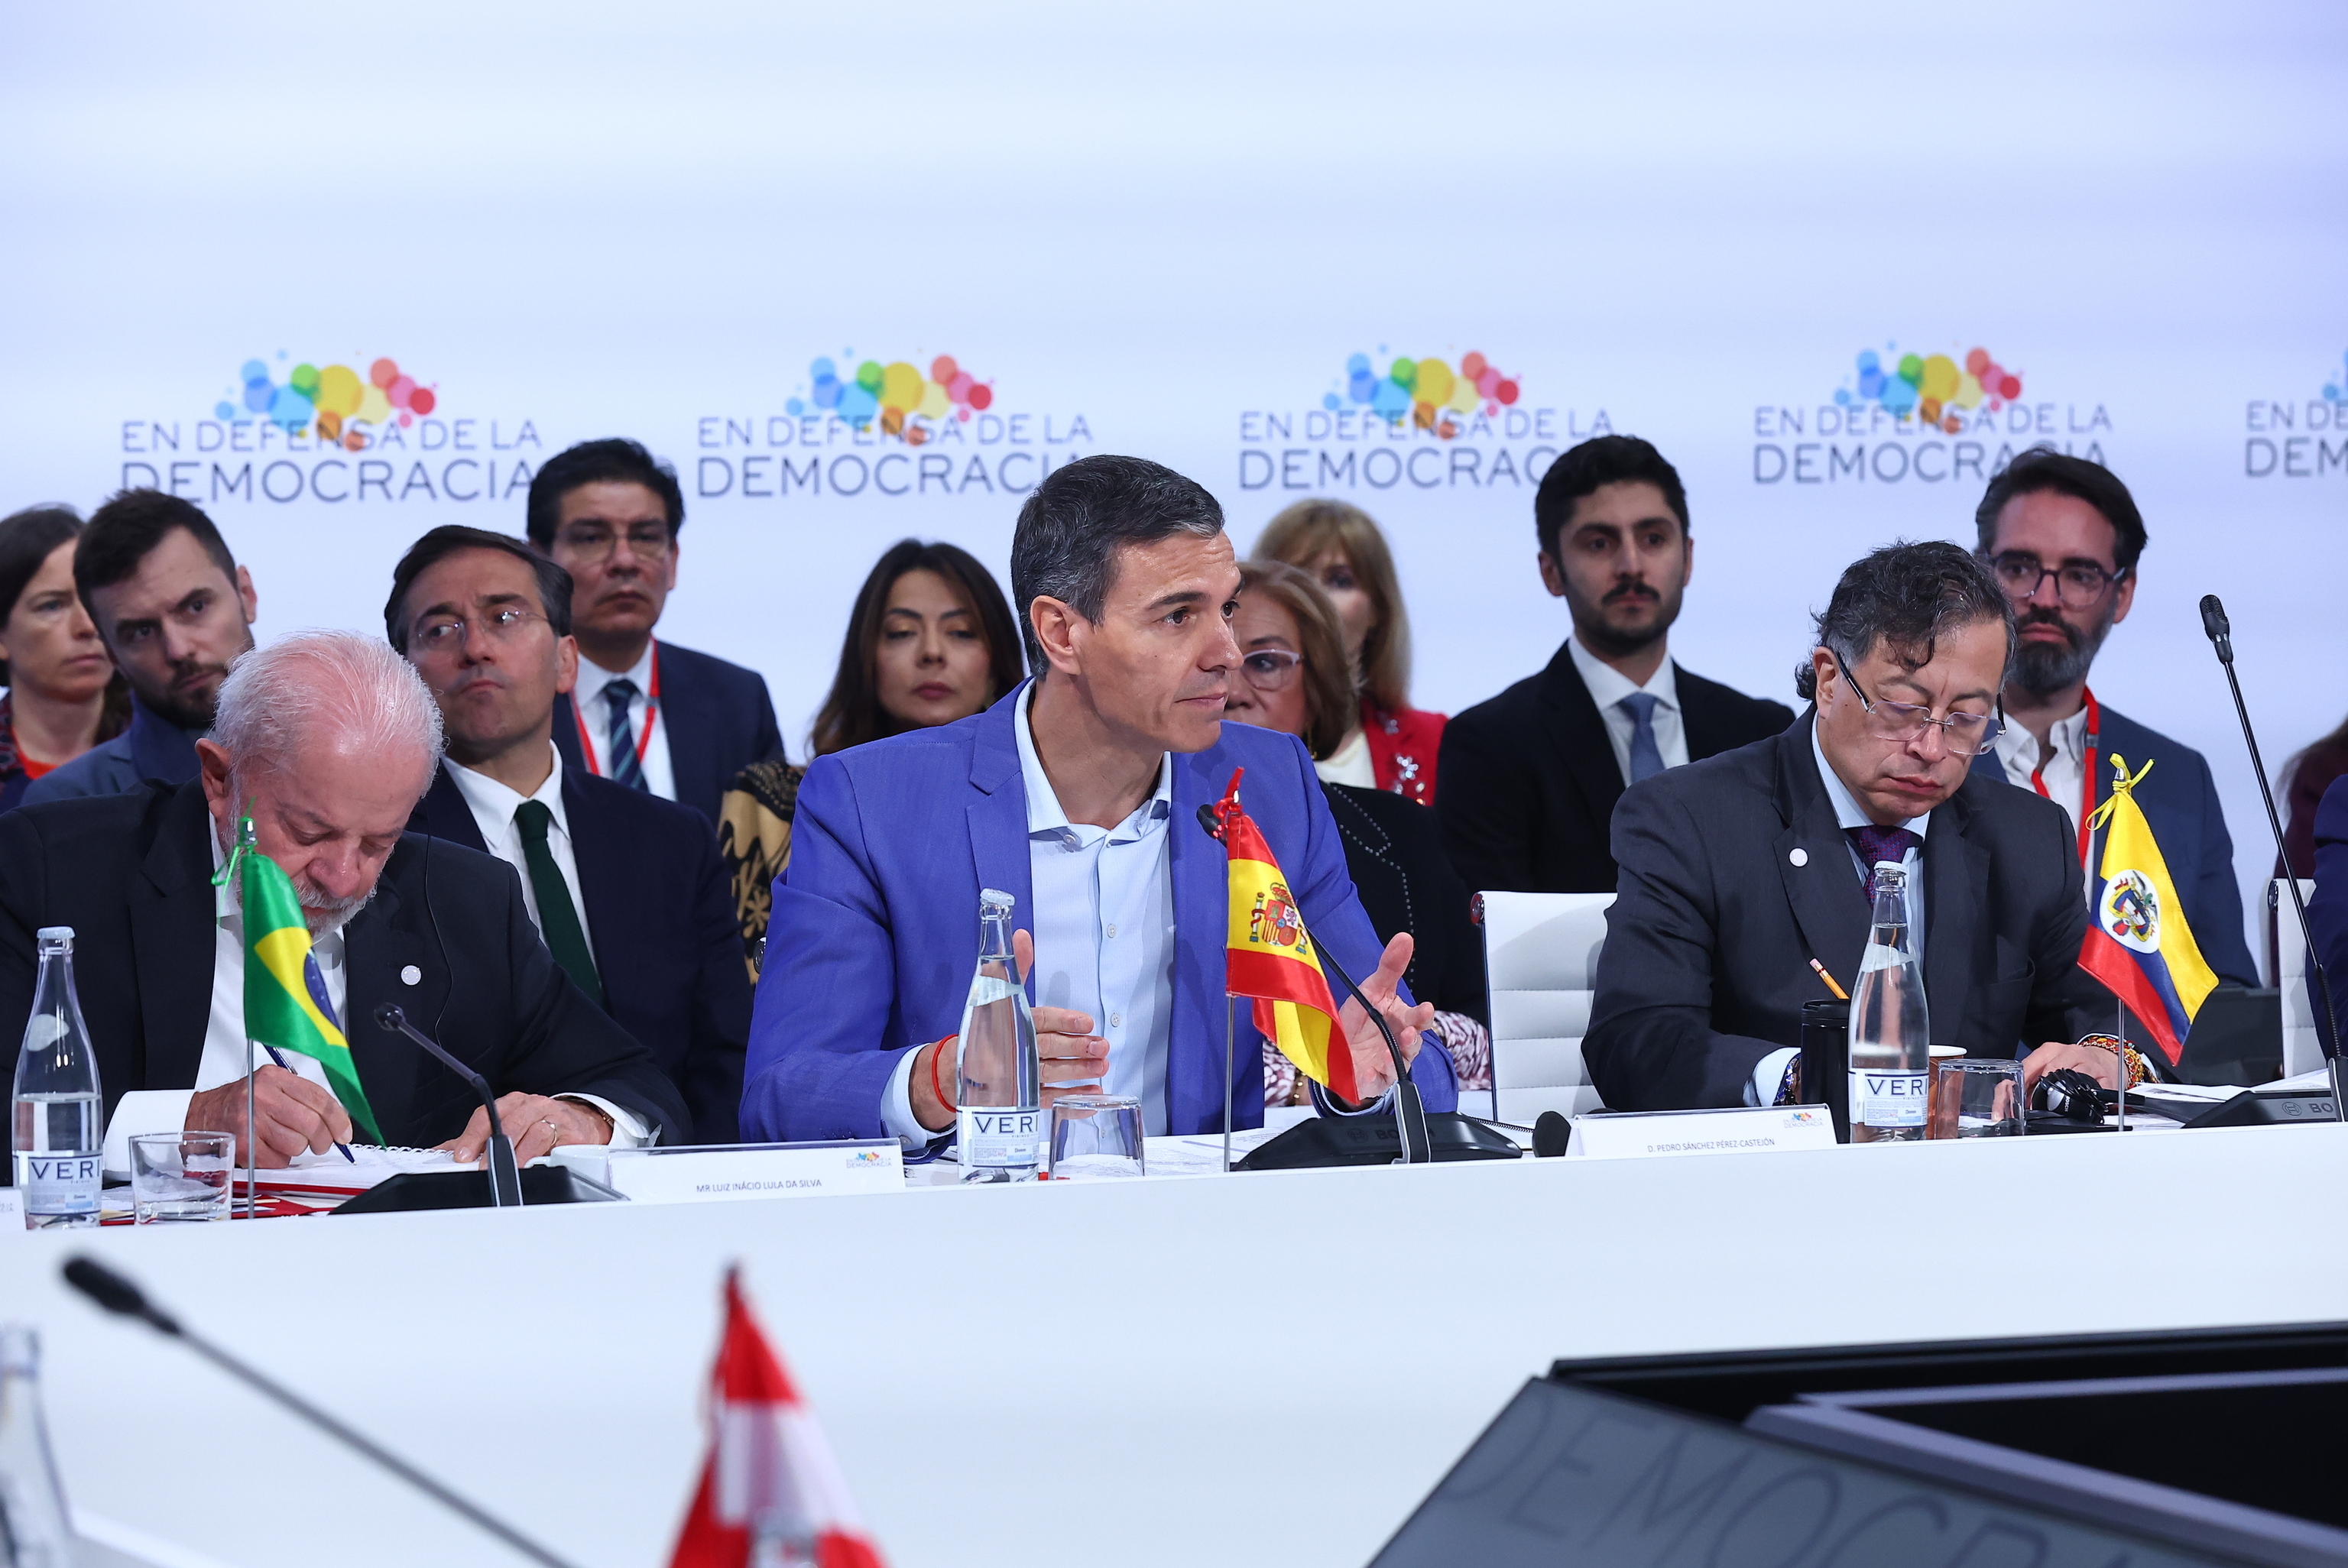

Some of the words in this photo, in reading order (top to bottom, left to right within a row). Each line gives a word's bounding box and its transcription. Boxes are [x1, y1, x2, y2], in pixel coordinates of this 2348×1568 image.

[699, 416, 753, 448] EN
[767, 413, 965, 447] DEFENSA
[978, 413, 1031, 445] DE
[1044, 413, 1094, 444] LA
[1240, 410, 1292, 442] EN
[1305, 408, 1493, 441] DEFENSA
[1505, 408, 1557, 440] DE
[1569, 407, 1615, 438] LA
[1754, 406, 1804, 437] EN
[1817, 403, 1996, 436] DEFENSA
[2007, 403, 2056, 435] DE
[2067, 403, 2113, 434] LA
[2246, 400, 2294, 431] EN
[122, 420, 180, 452] EN
[196, 418, 407, 452] DEFENSA
[420, 418, 477, 451] DE
[491, 418, 542, 450] LA
[698, 452, 1081, 497] DEMOCRACI
[1239, 445, 1559, 491] DEMOCRAC
[1866, 1077, 1928, 1096] VERI
[974, 1115, 1039, 1134] VERI
[1657, 1143, 1682, 1152] PEDRO
[1683, 1141, 1715, 1151] SÁNCHEZ
[1716, 1138, 1776, 1149] PÉREZ-CASTEJÓN
[30, 1159, 100, 1180] VERI
[712, 1183, 731, 1192] LUIZ
[732, 1180, 761, 1191] INÁCIO
[763, 1181, 784, 1190] LULA
[786, 1180, 798, 1188] DA
[799, 1178, 822, 1188] SILVA
